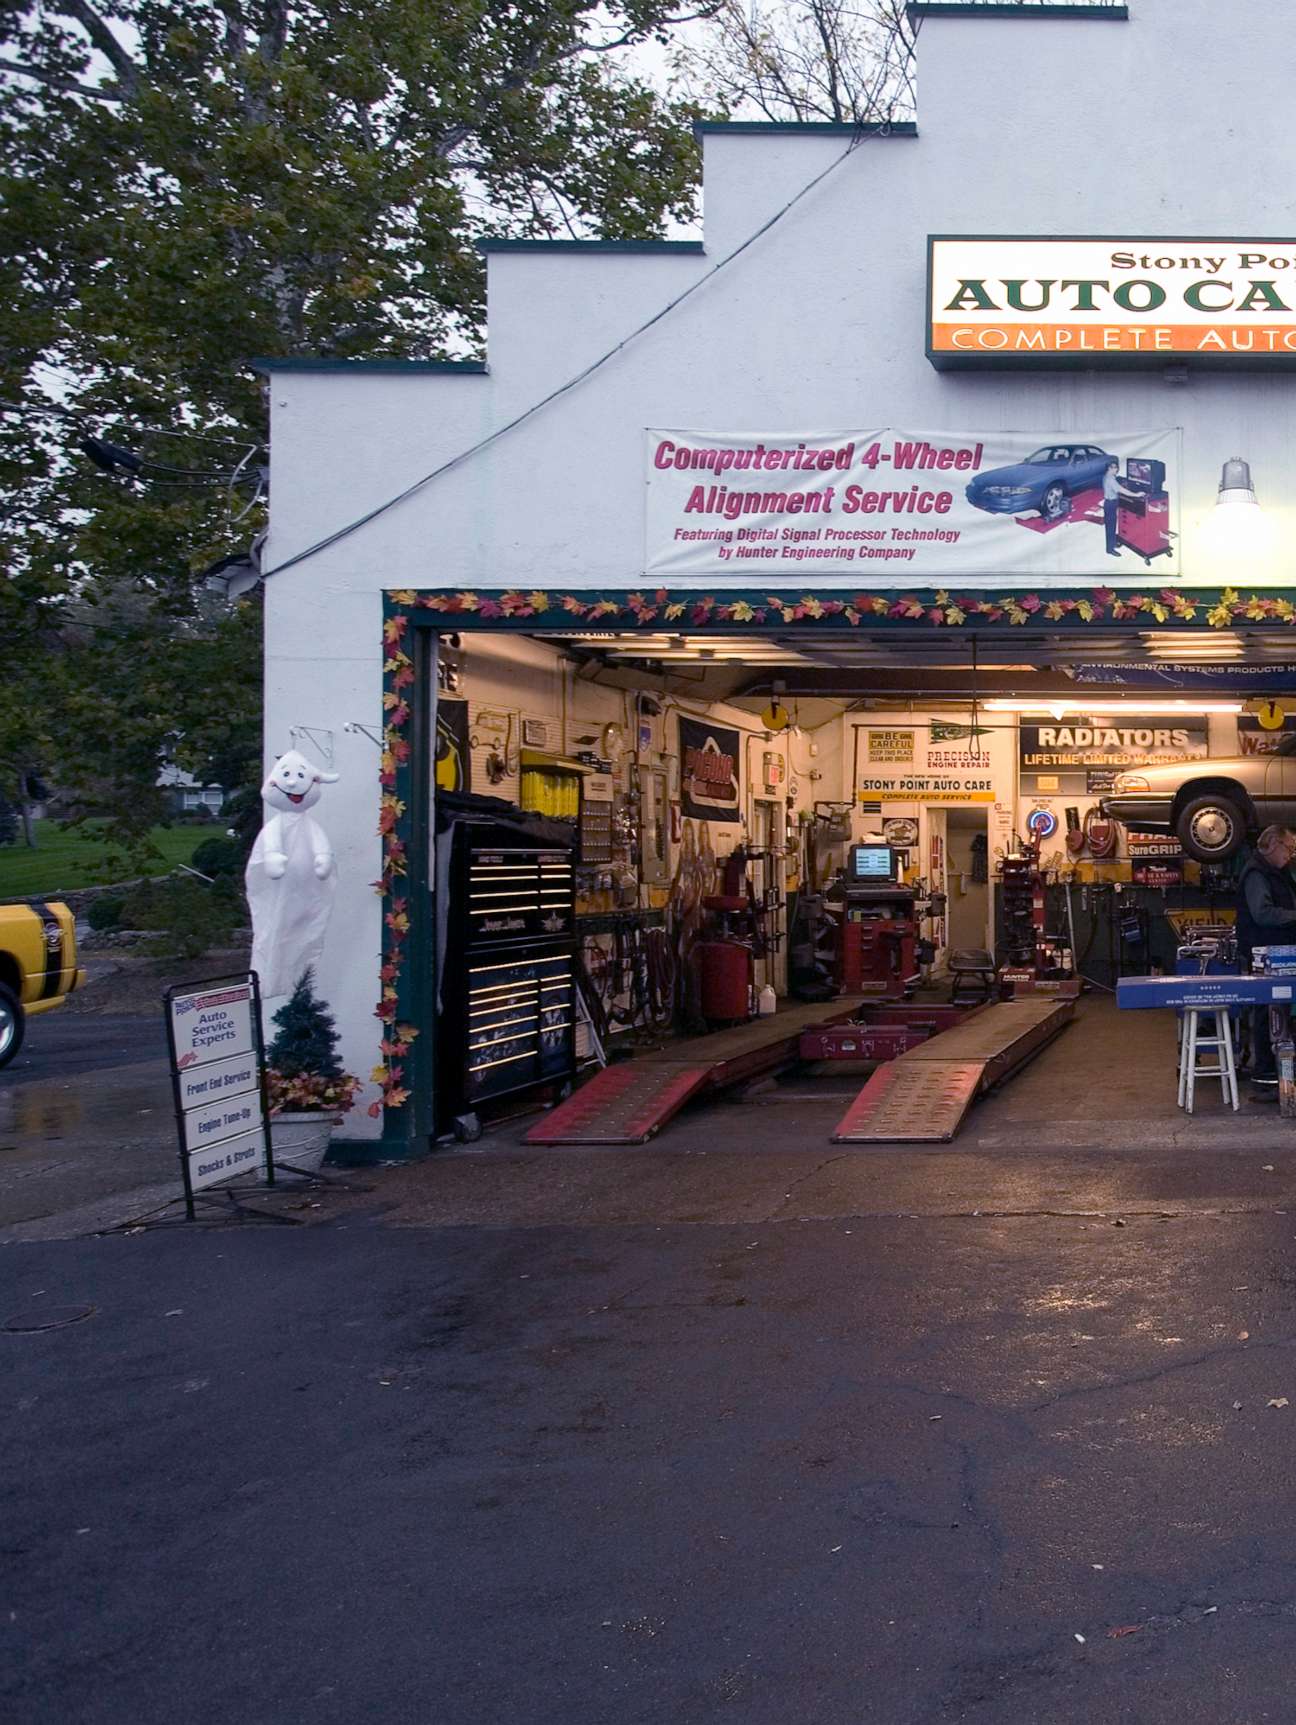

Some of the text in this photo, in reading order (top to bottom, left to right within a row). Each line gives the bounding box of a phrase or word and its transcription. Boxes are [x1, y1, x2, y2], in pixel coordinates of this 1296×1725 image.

[1111, 252, 1224, 274] Stony
[943, 279, 1166, 312] AUTO
[951, 328, 1173, 350] COMPLETE
[654, 441, 983, 476] Computerized 4-Wheel
[684, 485, 953, 519] Alignment Service
[674, 528, 961, 544] Featuring Digital Signal Processor Technology
[718, 546, 916, 561] by Hunter Engineering Company
[1174, 665, 1225, 673] SYSTEMS
[1227, 665, 1285, 673] PRODUCTS
[871, 740, 912, 748] CAREFUL
[885, 732, 898, 740] BE
[1038, 727, 1189, 747] RADIATORS
[928, 751, 990, 761] PRECISION
[1024, 753, 1079, 765] LIFETIME
[1083, 753, 1131, 765] LIMITED
[863, 780, 992, 790] STONY POINT AUTO CARE
[1128, 845, 1182, 855] SureGRIP
[200, 1012, 227, 1024] Auto
[192, 1020, 234, 1037] Service
[192, 1031, 236, 1047] Experts
[187, 1071, 251, 1096] Front End Service
[198, 1108, 251, 1133] Engine Tune-Up
[198, 1148, 255, 1176] Shocks & Struts
